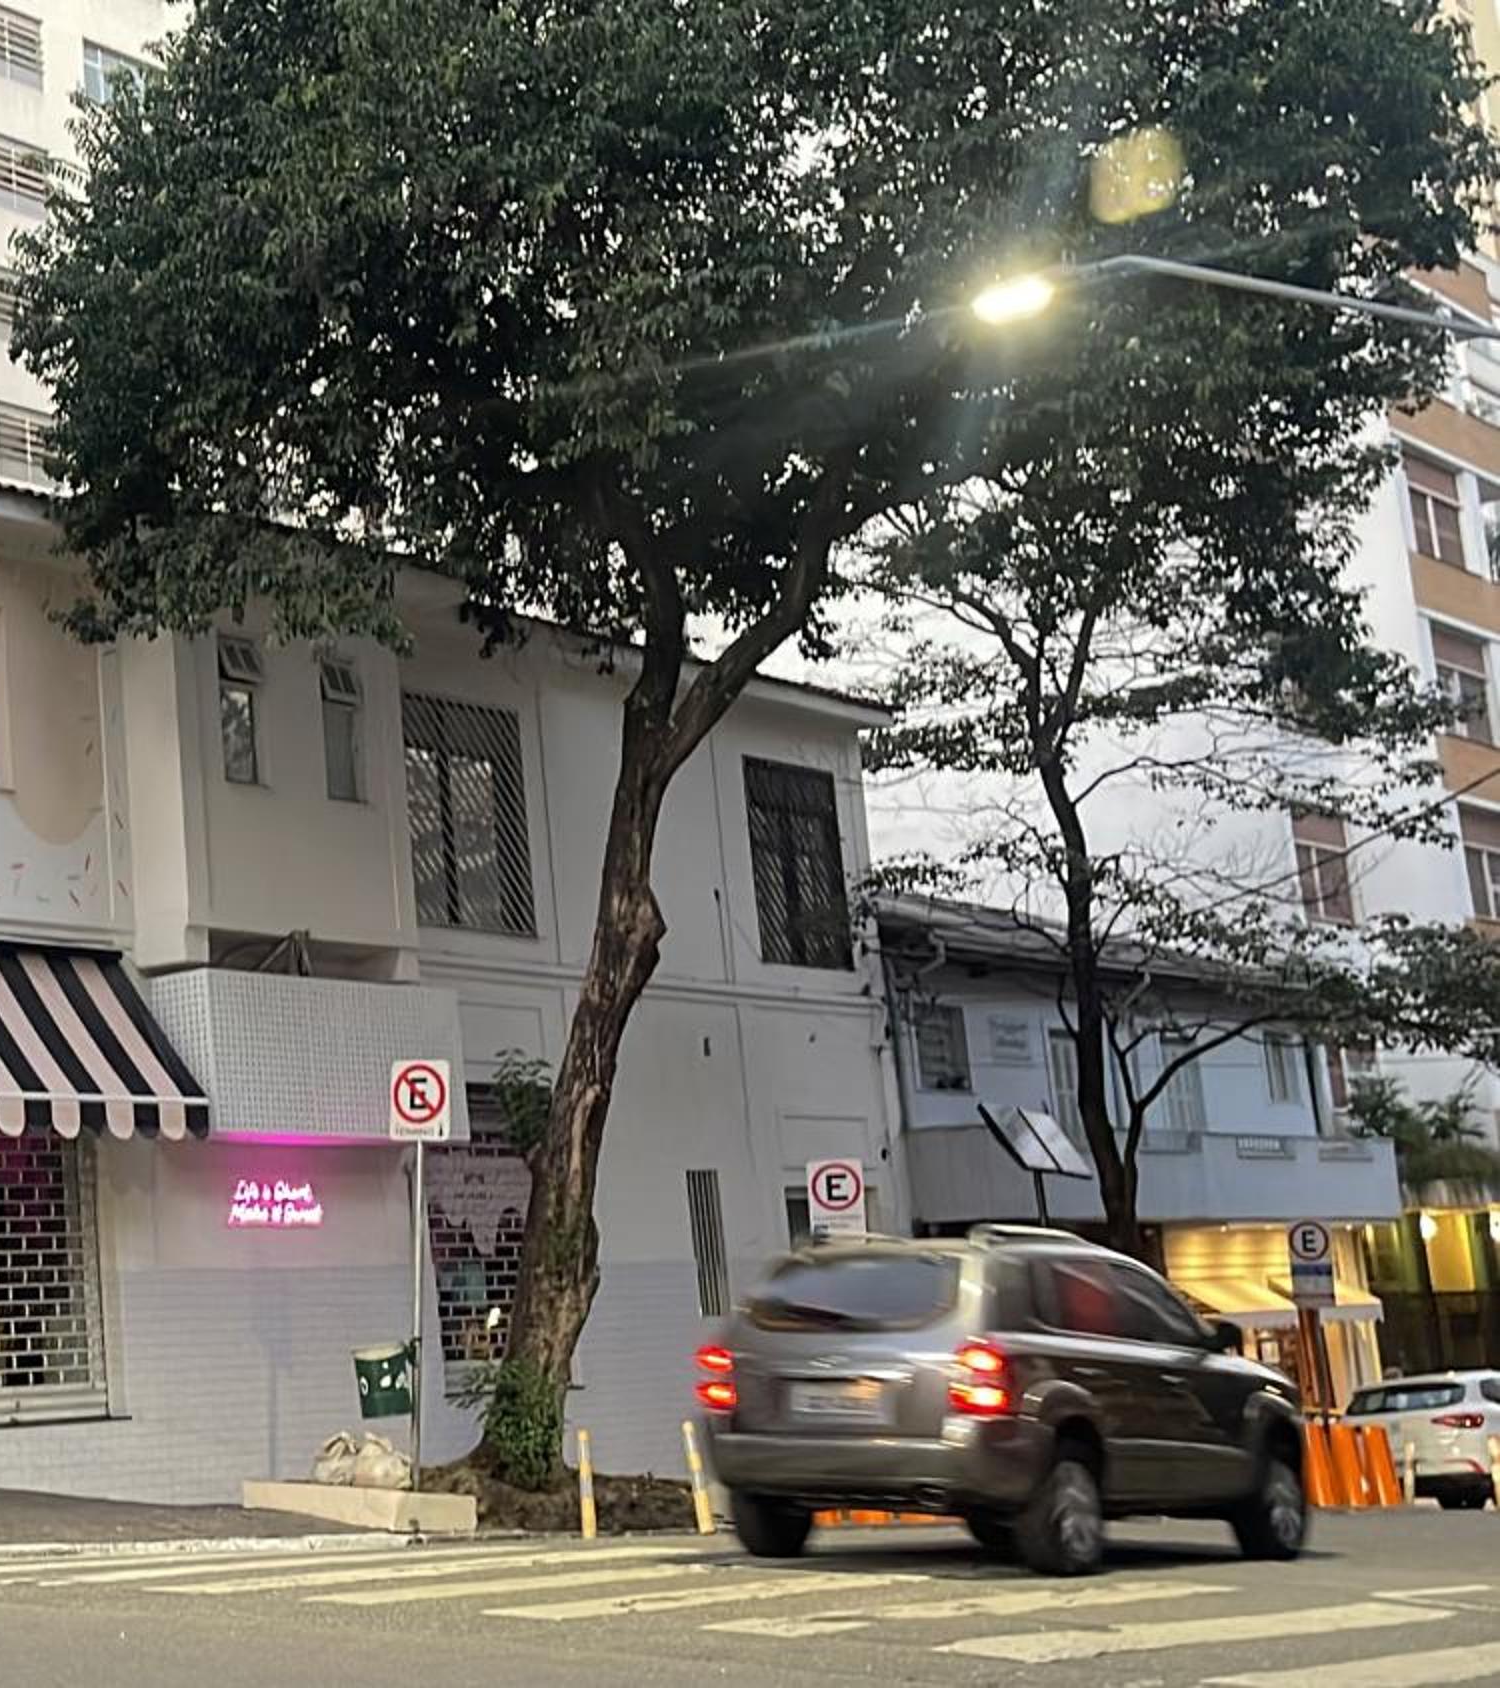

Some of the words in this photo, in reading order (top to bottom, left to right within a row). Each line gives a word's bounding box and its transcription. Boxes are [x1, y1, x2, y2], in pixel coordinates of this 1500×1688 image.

[410, 1077, 428, 1109] E
[826, 1174, 849, 1201] E
[1302, 1231, 1317, 1252] E
